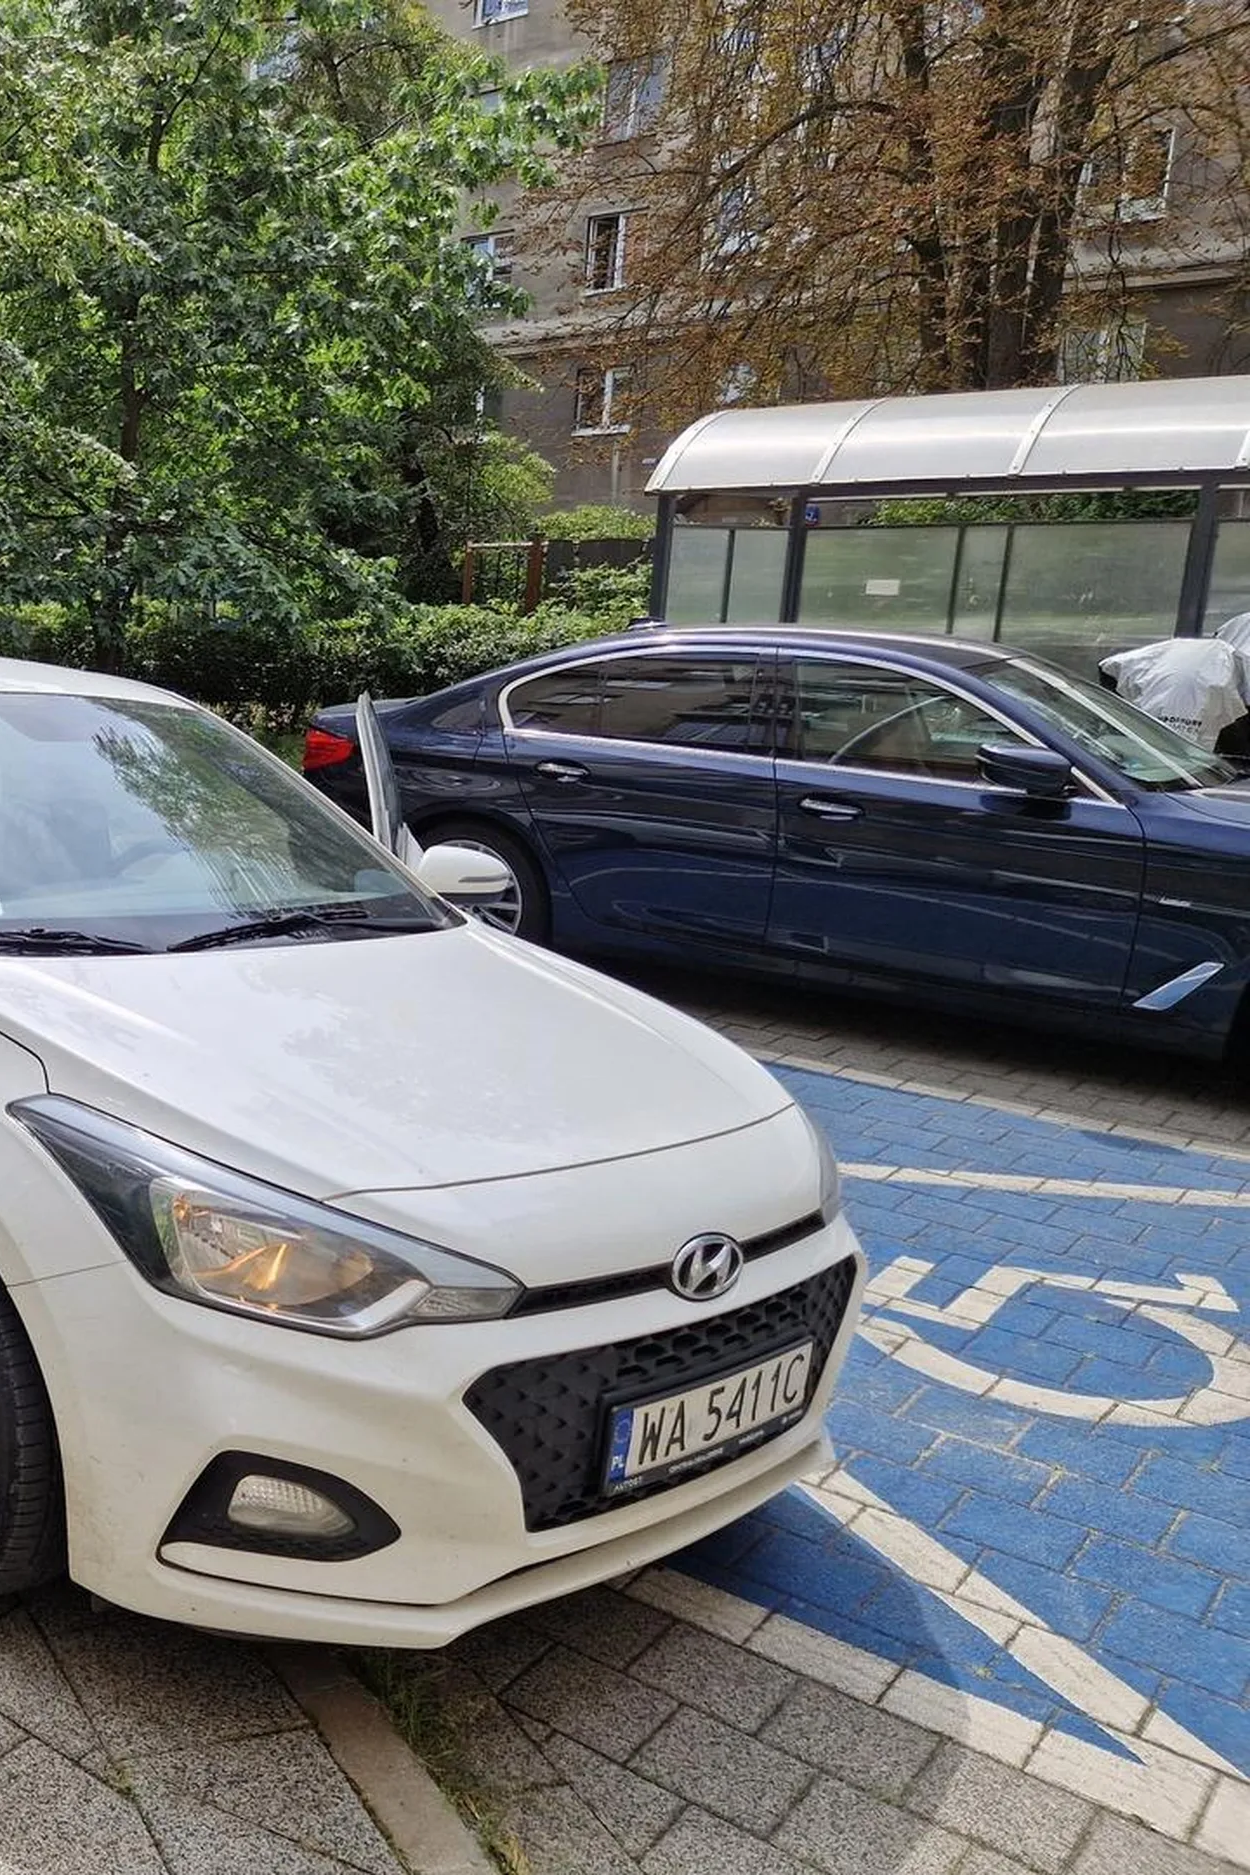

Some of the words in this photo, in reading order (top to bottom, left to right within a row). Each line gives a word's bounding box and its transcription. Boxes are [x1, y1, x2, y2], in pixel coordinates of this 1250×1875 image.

[637, 1400, 687, 1466] WA
[703, 1353, 805, 1442] 5411C
[610, 1454, 625, 1472] PL
